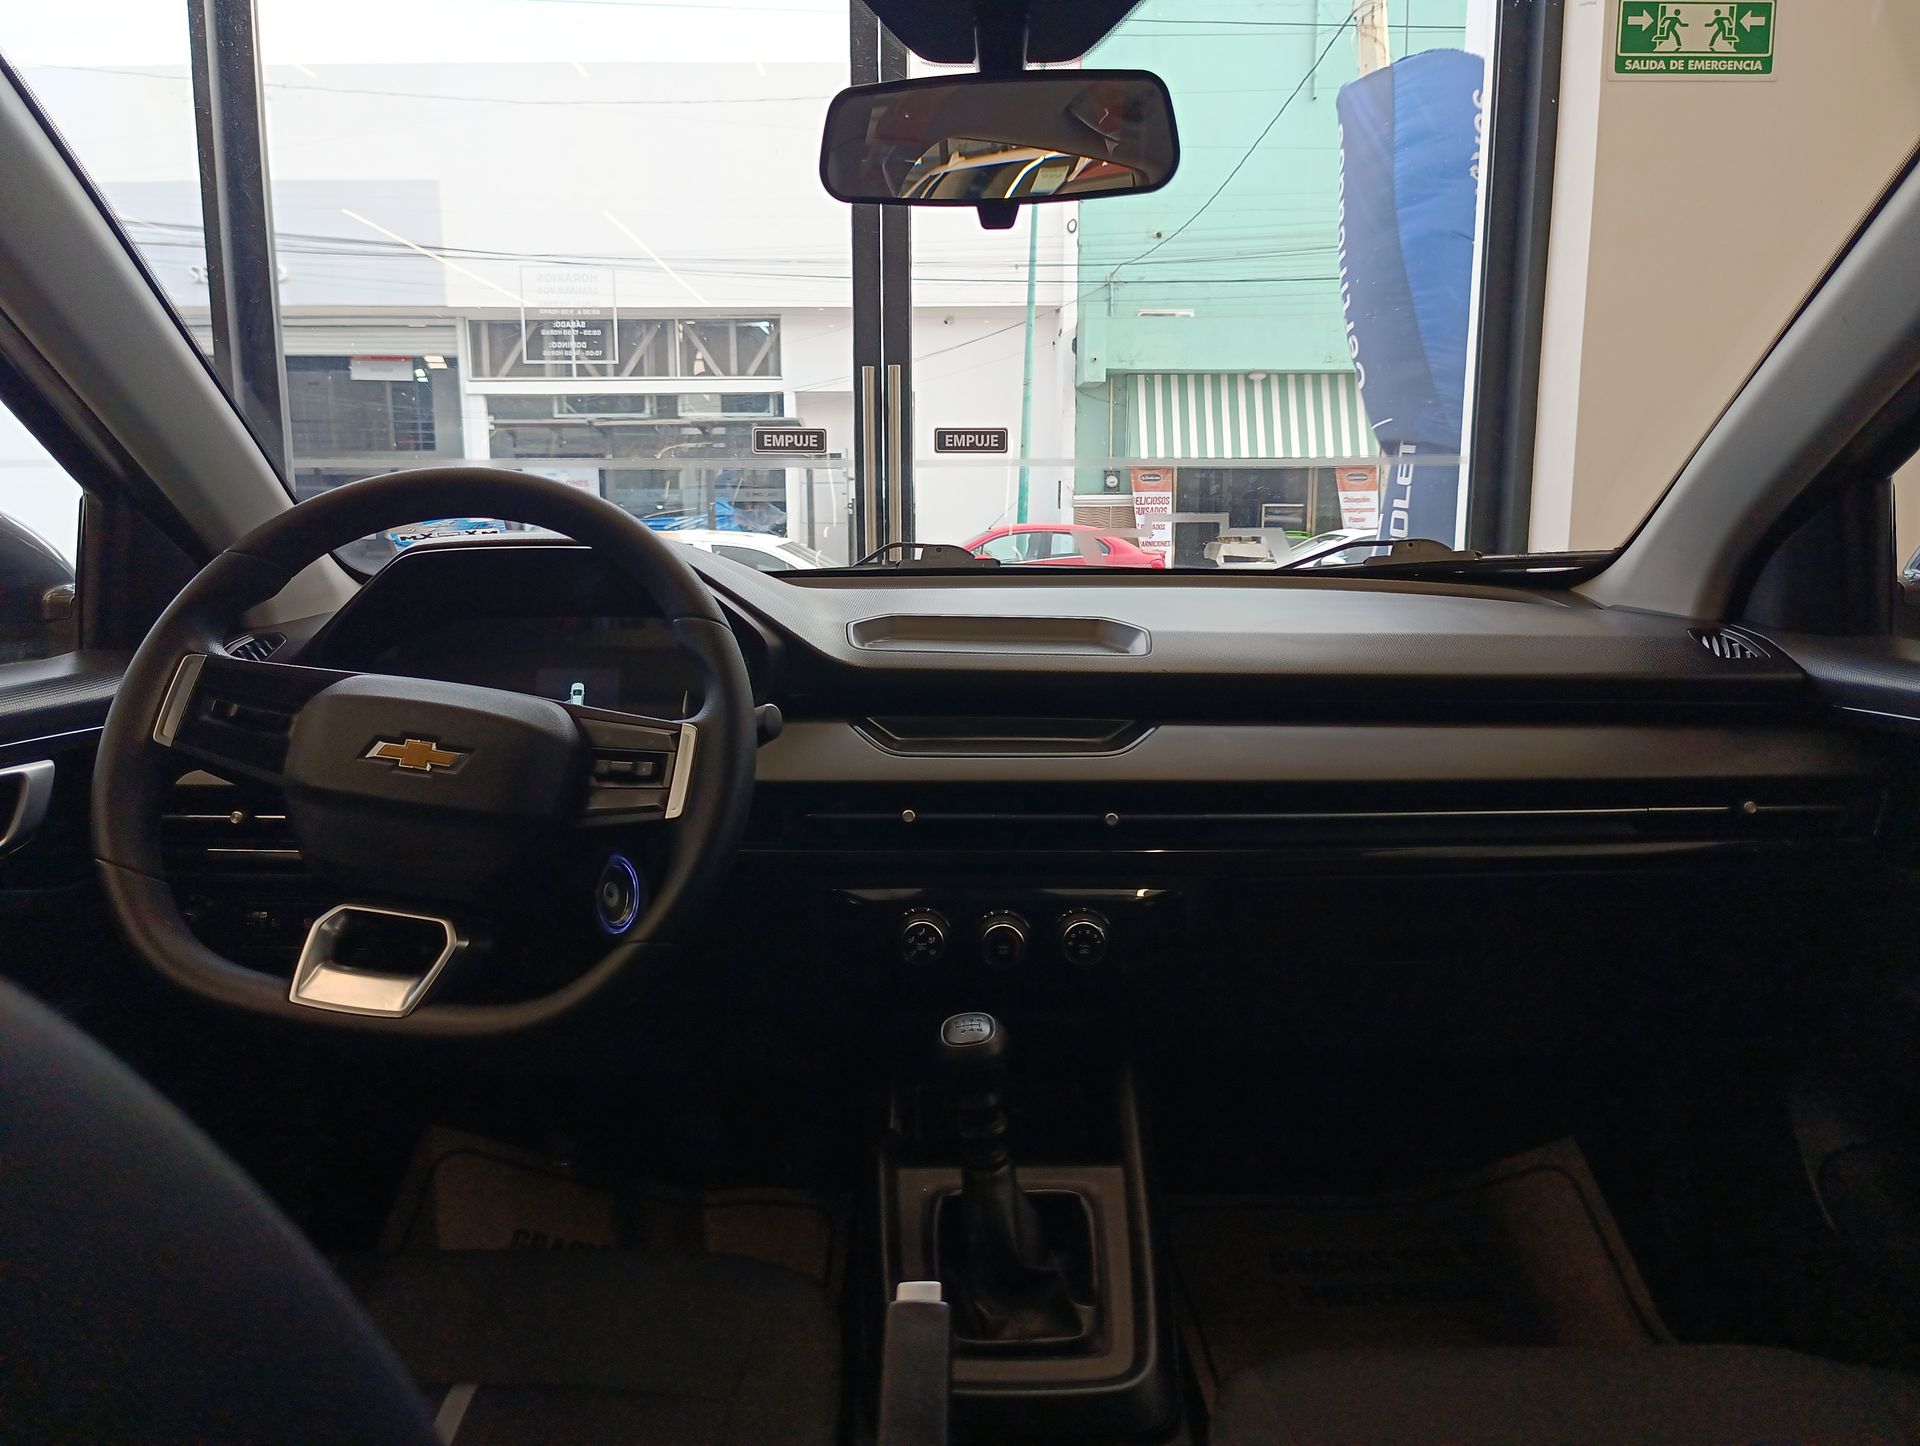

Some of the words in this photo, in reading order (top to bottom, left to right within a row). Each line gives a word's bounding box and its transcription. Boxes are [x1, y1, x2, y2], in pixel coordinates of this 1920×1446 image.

[1625, 60, 1666, 70] SALIDA
[1669, 60, 1684, 70] DE
[1688, 60, 1763, 71] EMERGENCIA
[763, 434, 818, 447] EMPUJE
[945, 434, 999, 447] EMPUJE
[1389, 441, 1417, 540] OLET
